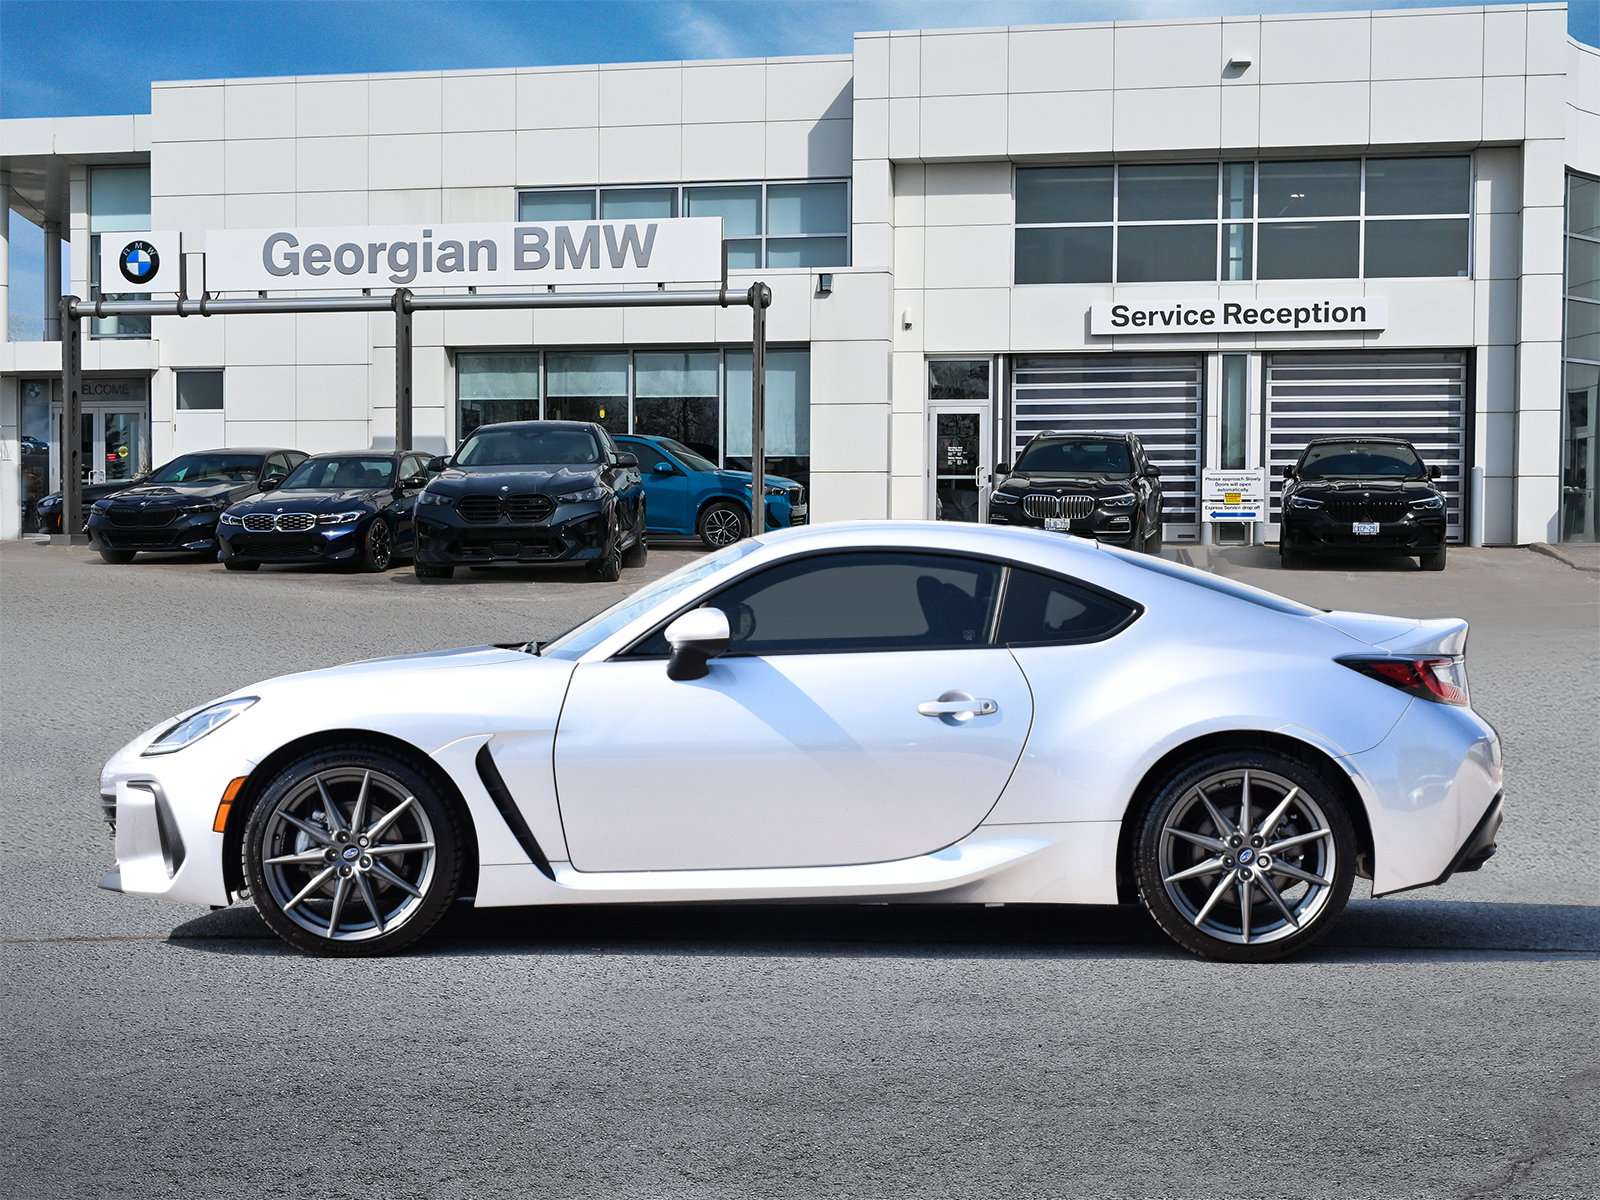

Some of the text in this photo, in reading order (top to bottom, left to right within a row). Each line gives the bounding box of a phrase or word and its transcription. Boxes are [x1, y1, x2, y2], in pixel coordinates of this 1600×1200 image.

[262, 223, 658, 284] Georgian BMW
[1111, 301, 1367, 328] Service Reception
[81, 383, 130, 396] ELCOME
